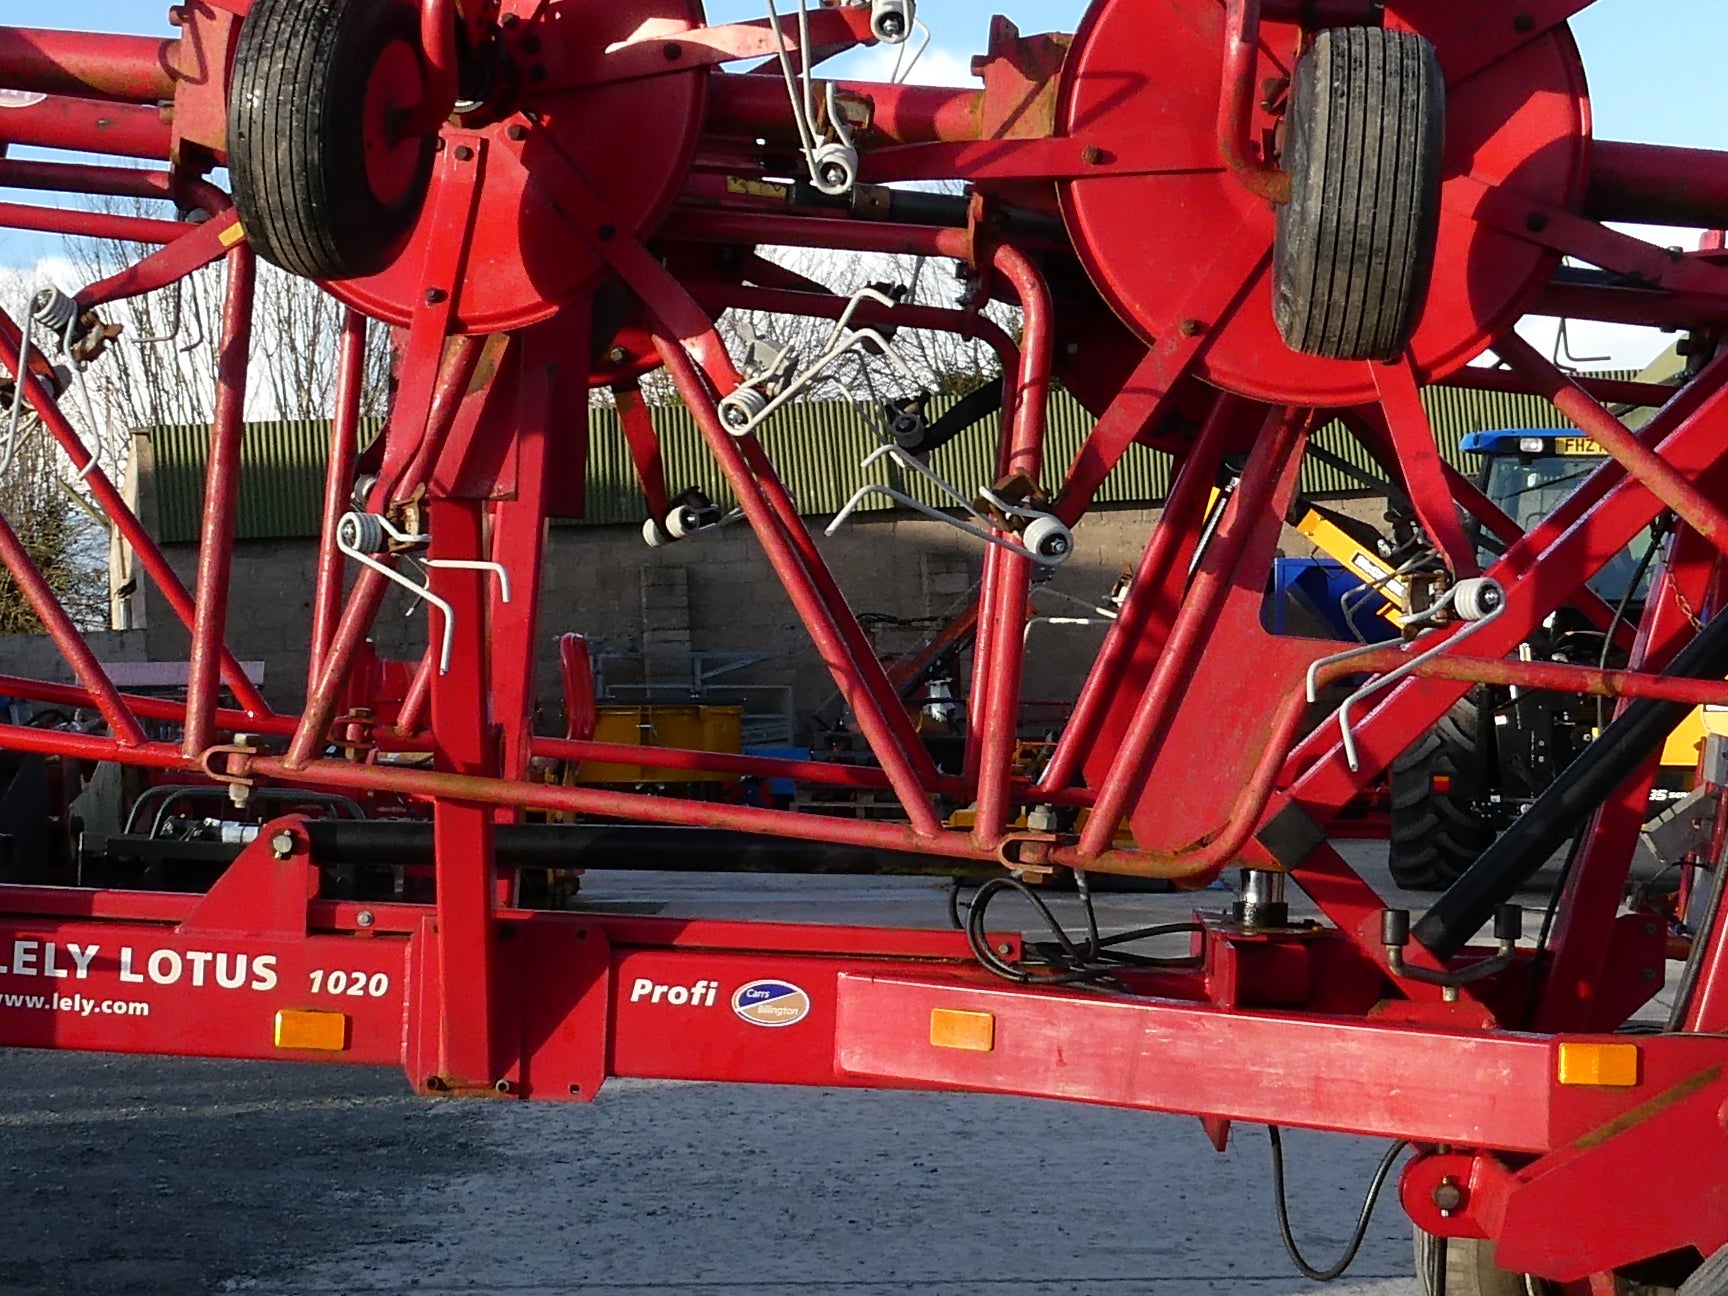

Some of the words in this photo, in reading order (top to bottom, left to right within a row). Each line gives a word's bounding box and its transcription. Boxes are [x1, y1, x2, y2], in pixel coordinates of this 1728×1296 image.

[119, 946, 278, 991] LOTUS
[308, 969, 390, 997] 1020
[630, 978, 720, 1007] Profi
